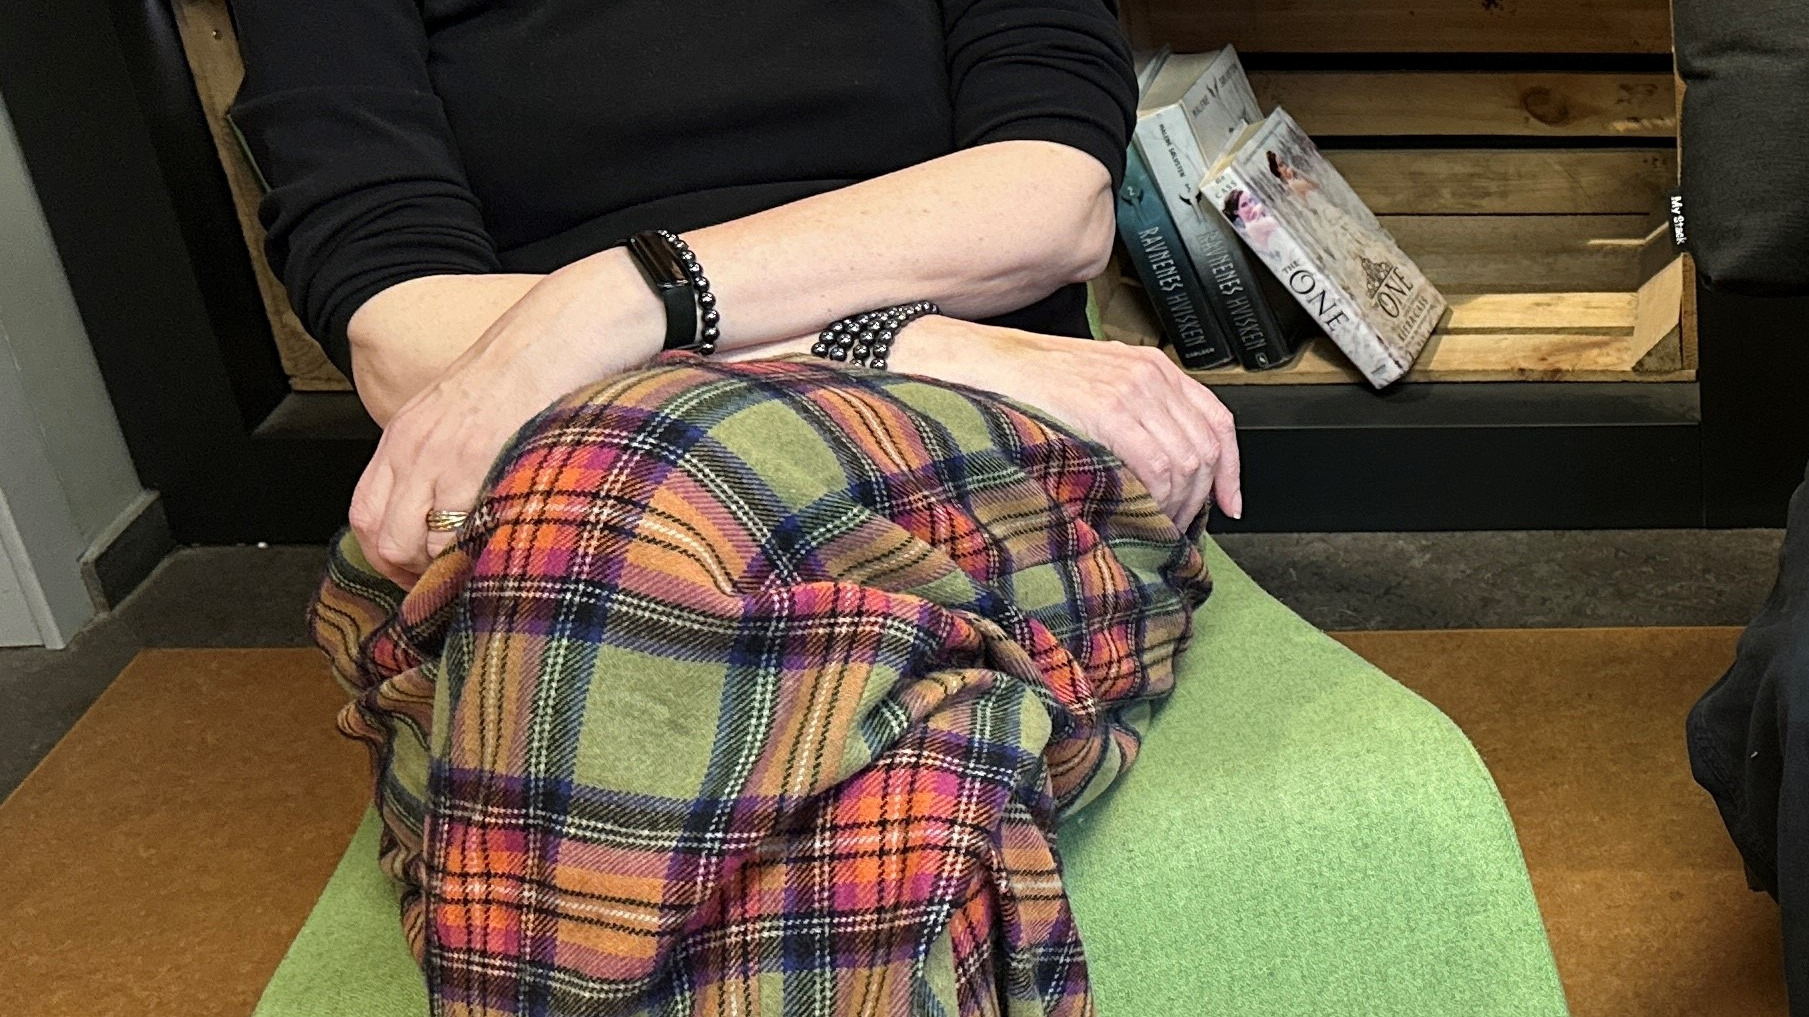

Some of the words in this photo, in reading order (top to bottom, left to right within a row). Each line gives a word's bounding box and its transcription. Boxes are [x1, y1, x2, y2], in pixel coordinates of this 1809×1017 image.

[1138, 226, 1184, 292] RAVNENES
[1166, 292, 1207, 347] HVISKEN
[1199, 229, 1244, 296] RAVNENES
[1226, 296, 1267, 351] HVISKEN
[1289, 269, 1350, 333] ONE
[1376, 265, 1415, 319] ONE
